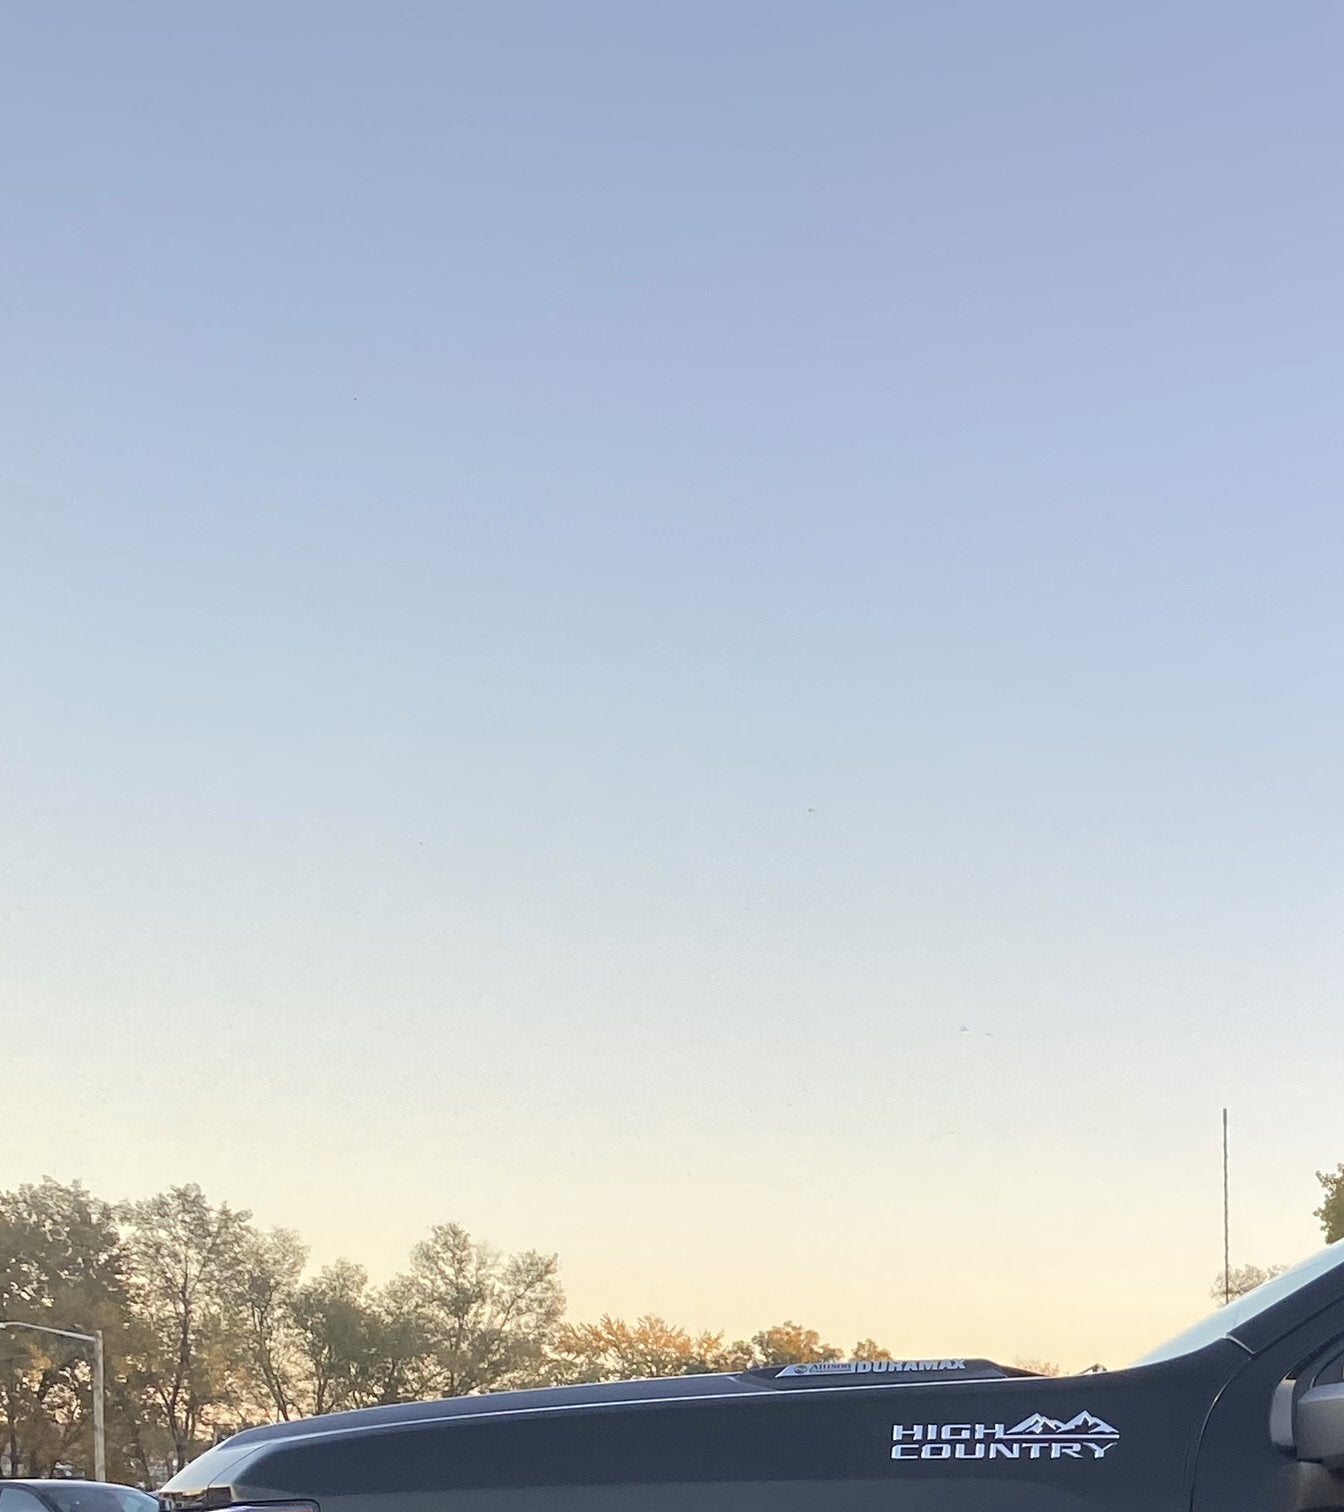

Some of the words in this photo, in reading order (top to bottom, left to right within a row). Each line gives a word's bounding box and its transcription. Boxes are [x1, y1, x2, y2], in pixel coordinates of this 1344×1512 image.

[856, 1359, 967, 1373] DURAMAX
[892, 1423, 1005, 1441] HIGH
[890, 1441, 1118, 1459] COUNTRY
